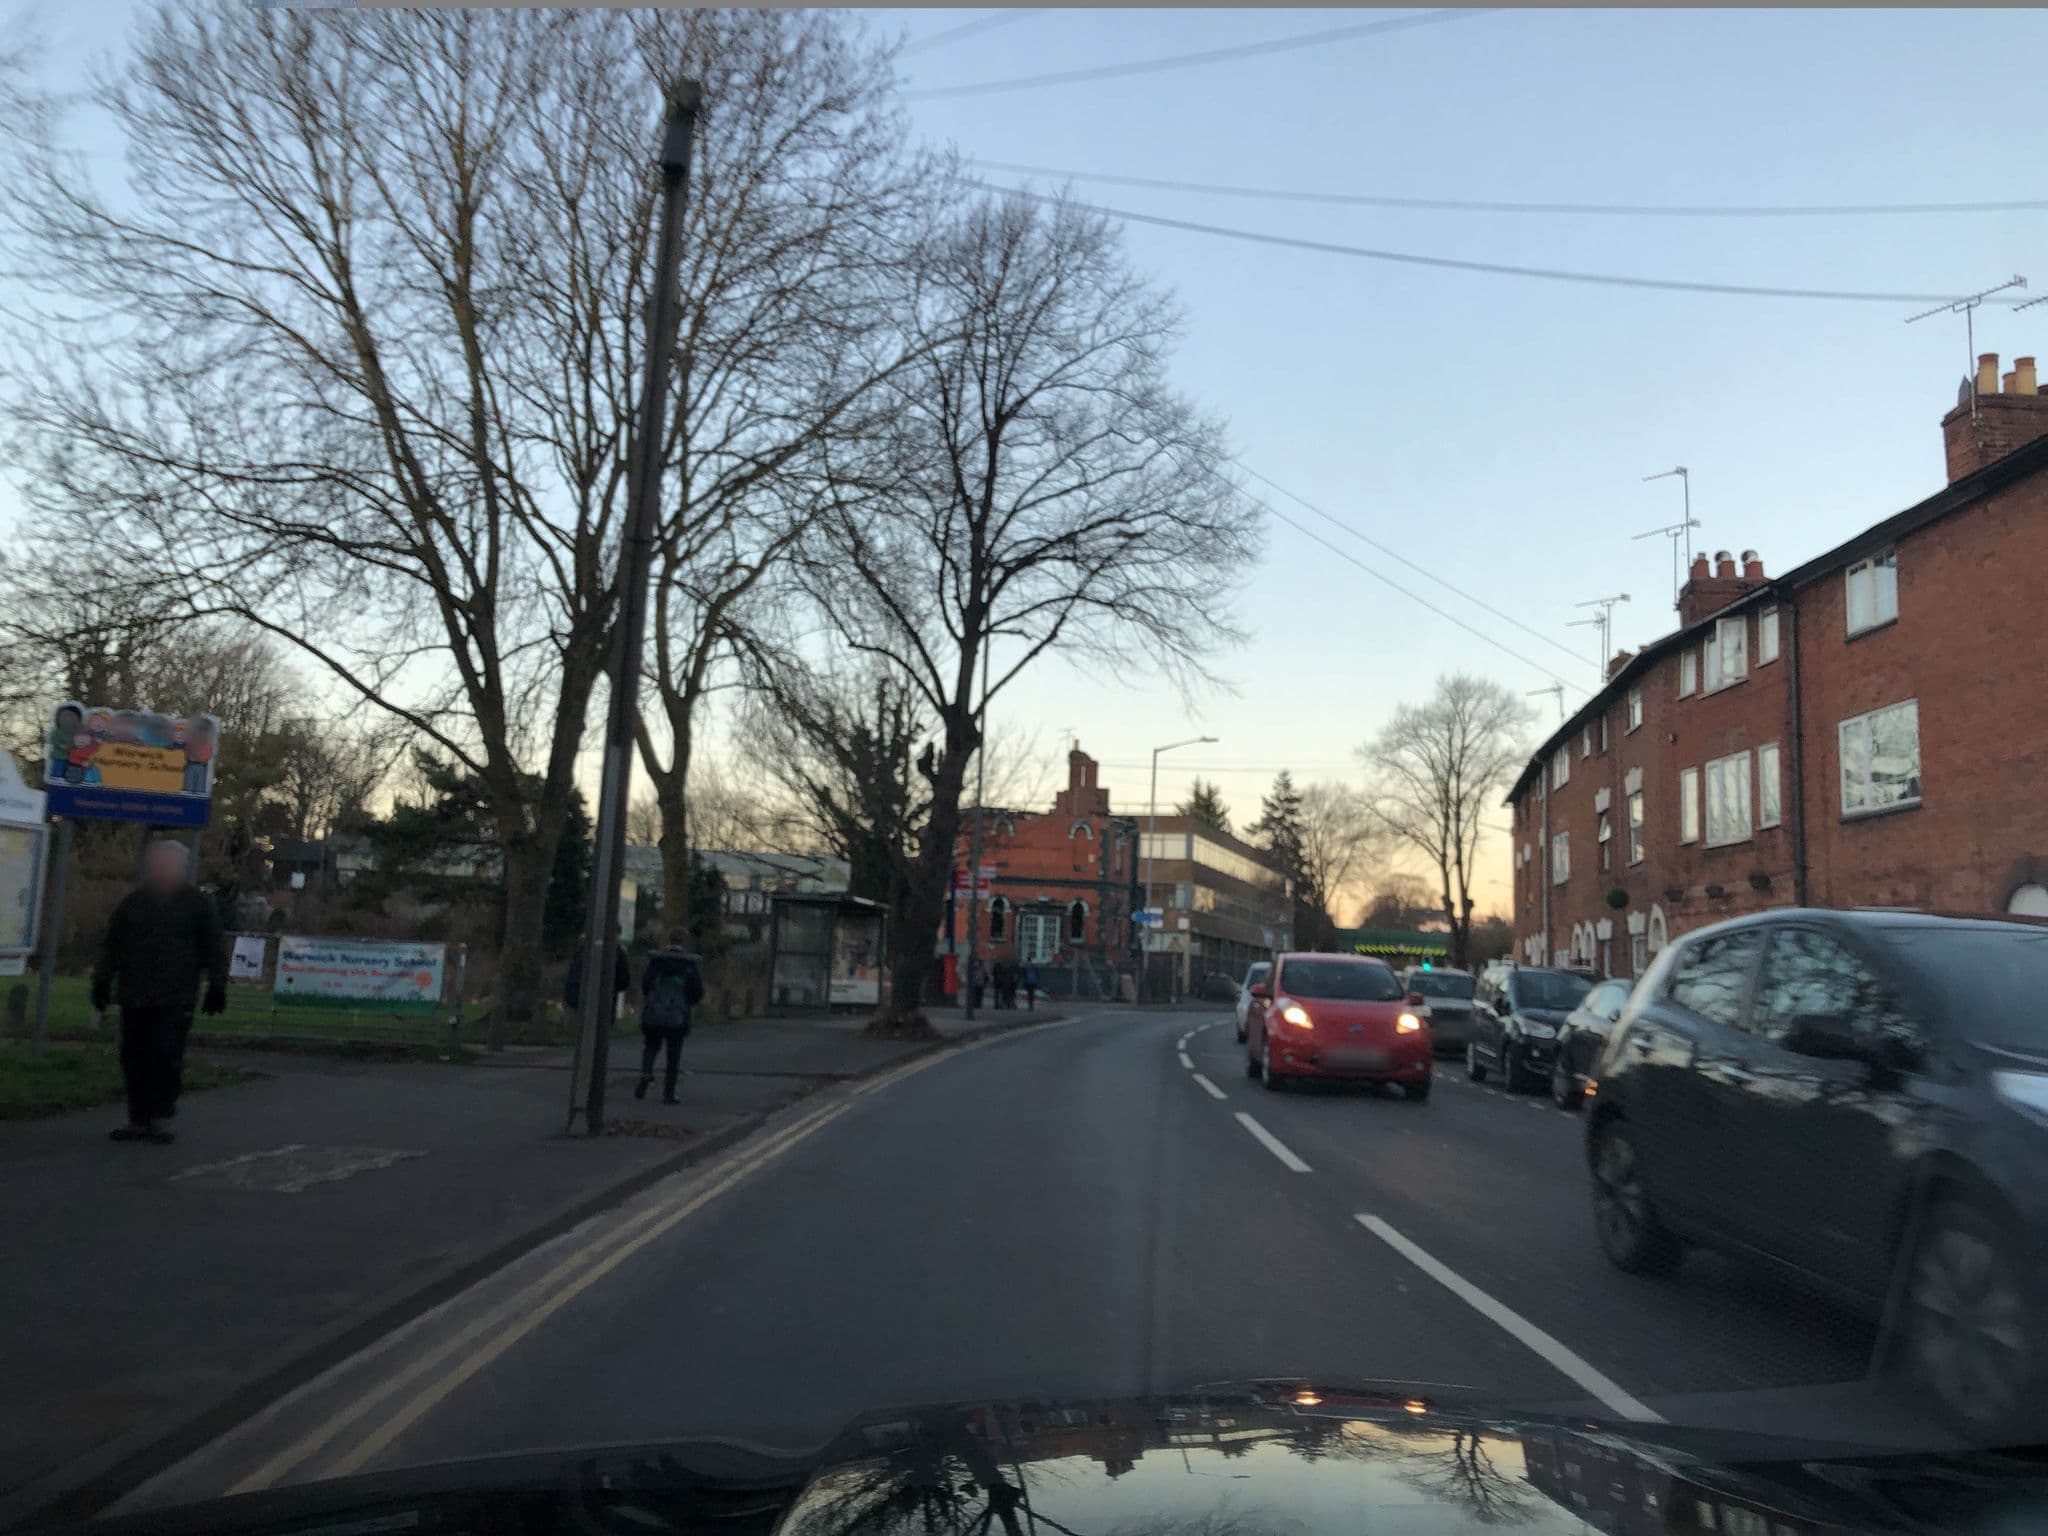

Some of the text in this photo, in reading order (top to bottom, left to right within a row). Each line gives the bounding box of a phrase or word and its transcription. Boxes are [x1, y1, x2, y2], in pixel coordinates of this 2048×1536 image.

[283, 951, 437, 968] Warwick Nursery School
